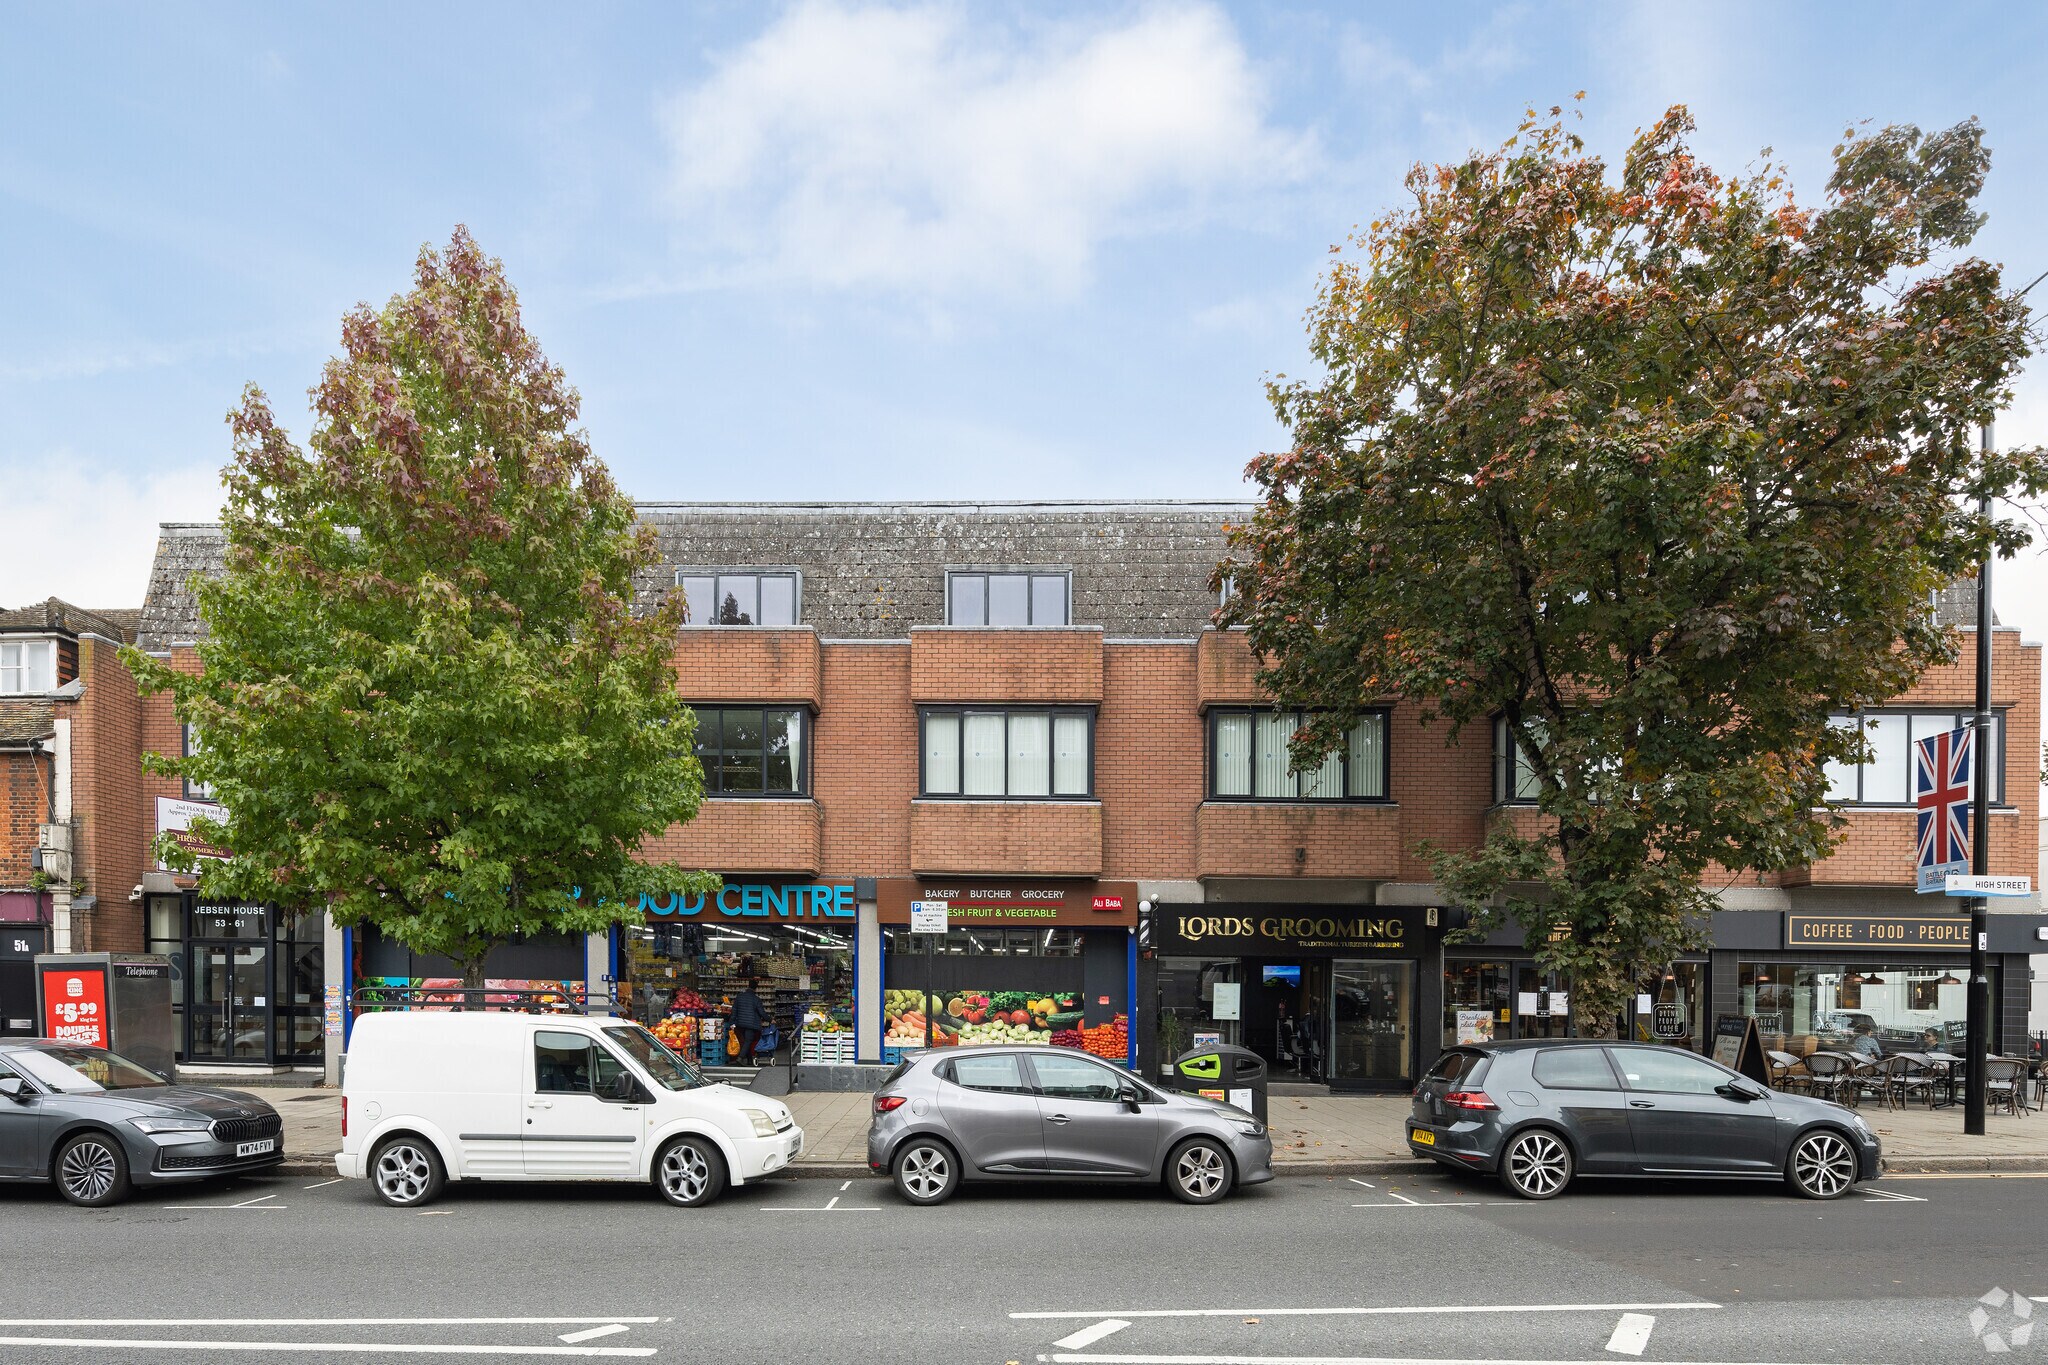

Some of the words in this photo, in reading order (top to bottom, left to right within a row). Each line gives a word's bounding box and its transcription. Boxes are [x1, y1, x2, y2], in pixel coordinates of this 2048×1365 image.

[1926, 870, 1943, 878] BATTLE
[1996, 881, 2027, 889] STREET
[925, 889, 960, 898] BAKERY
[970, 890, 1012, 898] BUTCHER
[1021, 890, 1065, 899] GROCERY
[716, 884, 854, 917] CENTRE
[194, 906, 230, 914] JEBSEN
[233, 907, 265, 915] HOUSE
[947, 908, 965, 917] ESH
[967, 908, 993, 917] FRUIT
[995, 909, 1002, 917] &
[1004, 909, 1057, 918] VEGETABLE
[215, 920, 226, 928] 53
[234, 920, 245, 928] 61
[1178, 916, 1255, 941] LORDS
[1260, 918, 1404, 940] GROOMING
[1803, 923, 1853, 938] COFFEE
[1869, 924, 1904, 939] FOOD
[1919, 925, 1970, 940] PEOPLE
[125, 966, 158, 976] Telephone
[55, 1002, 98, 1022] £5.99
[55, 1025, 99, 1036] DOUBLE
[240, 1143, 258, 1154] MW74
[260, 1141, 272, 1151] FVY
